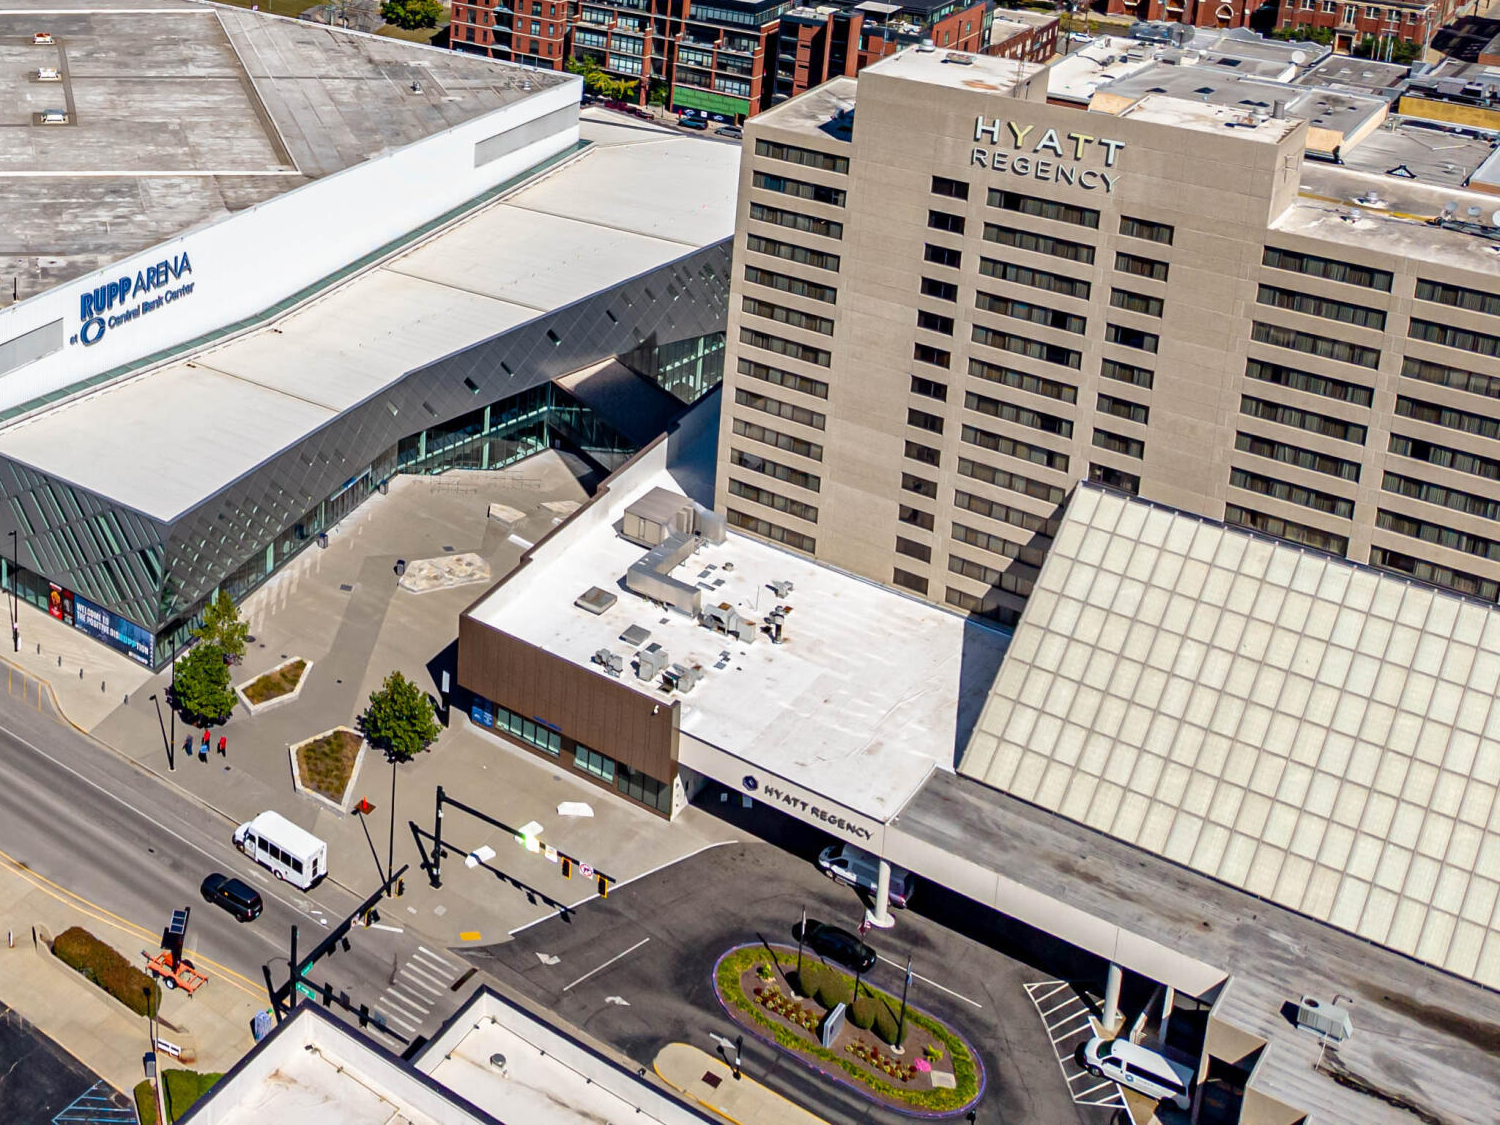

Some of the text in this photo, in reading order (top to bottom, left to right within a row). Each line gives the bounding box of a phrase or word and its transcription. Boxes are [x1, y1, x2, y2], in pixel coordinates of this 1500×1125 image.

[973, 115, 1126, 167] HYATT
[971, 147, 1121, 193] REGENCY
[80, 251, 192, 321] RUPP ARENA
[108, 305, 140, 329] Central
[141, 295, 164, 315] Bank
[164, 282, 195, 304] Center
[76, 602, 101, 622] WELCOME
[76, 610, 86, 622] THE
[764, 785, 875, 841] HYATT REGENCY
